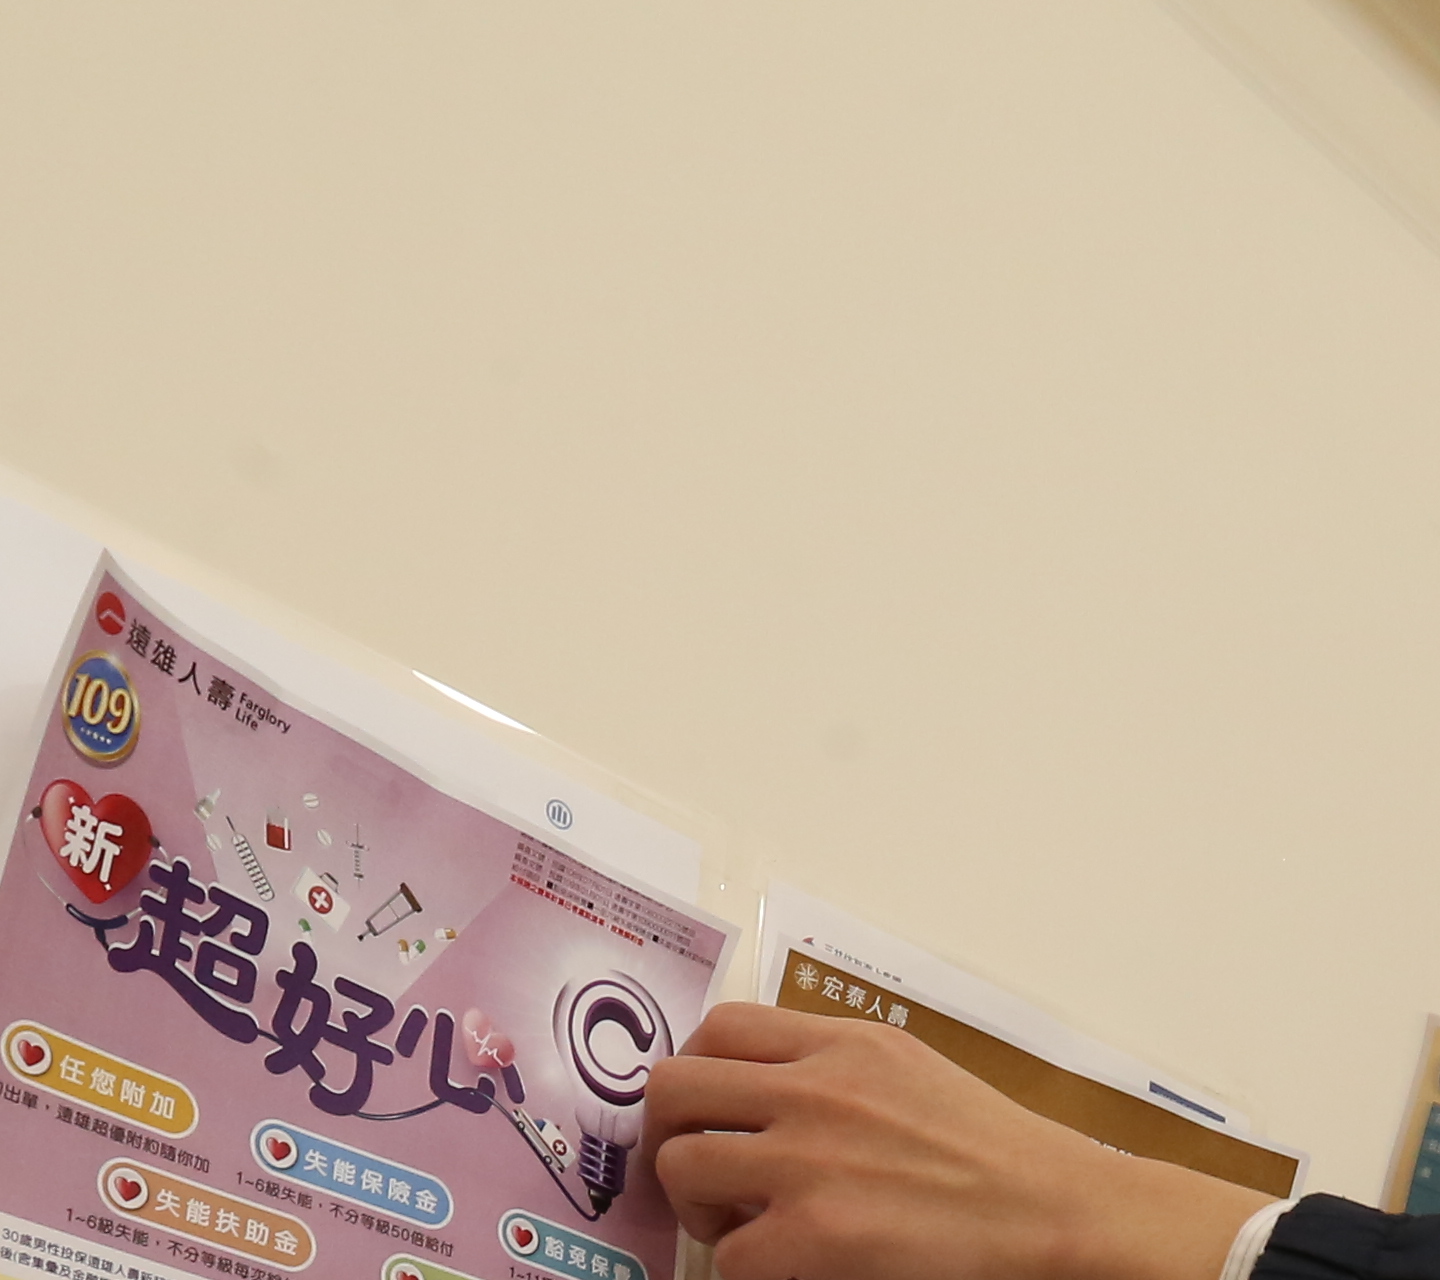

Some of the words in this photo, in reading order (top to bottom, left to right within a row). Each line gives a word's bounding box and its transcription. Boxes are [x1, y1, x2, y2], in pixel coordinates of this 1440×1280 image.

[68, 673, 132, 734] 109
[125, 618, 236, 712] 遠雄人壽
[238, 691, 291, 734] Farglory
[234, 709, 259, 731] Life
[63, 800, 127, 885] 新
[819, 974, 911, 1030] 宏泰人壽
[60, 1053, 176, 1120] 任您附加
[303, 1148, 438, 1215] 失能保險金
[154, 1187, 300, 1257] 失能扶助金
